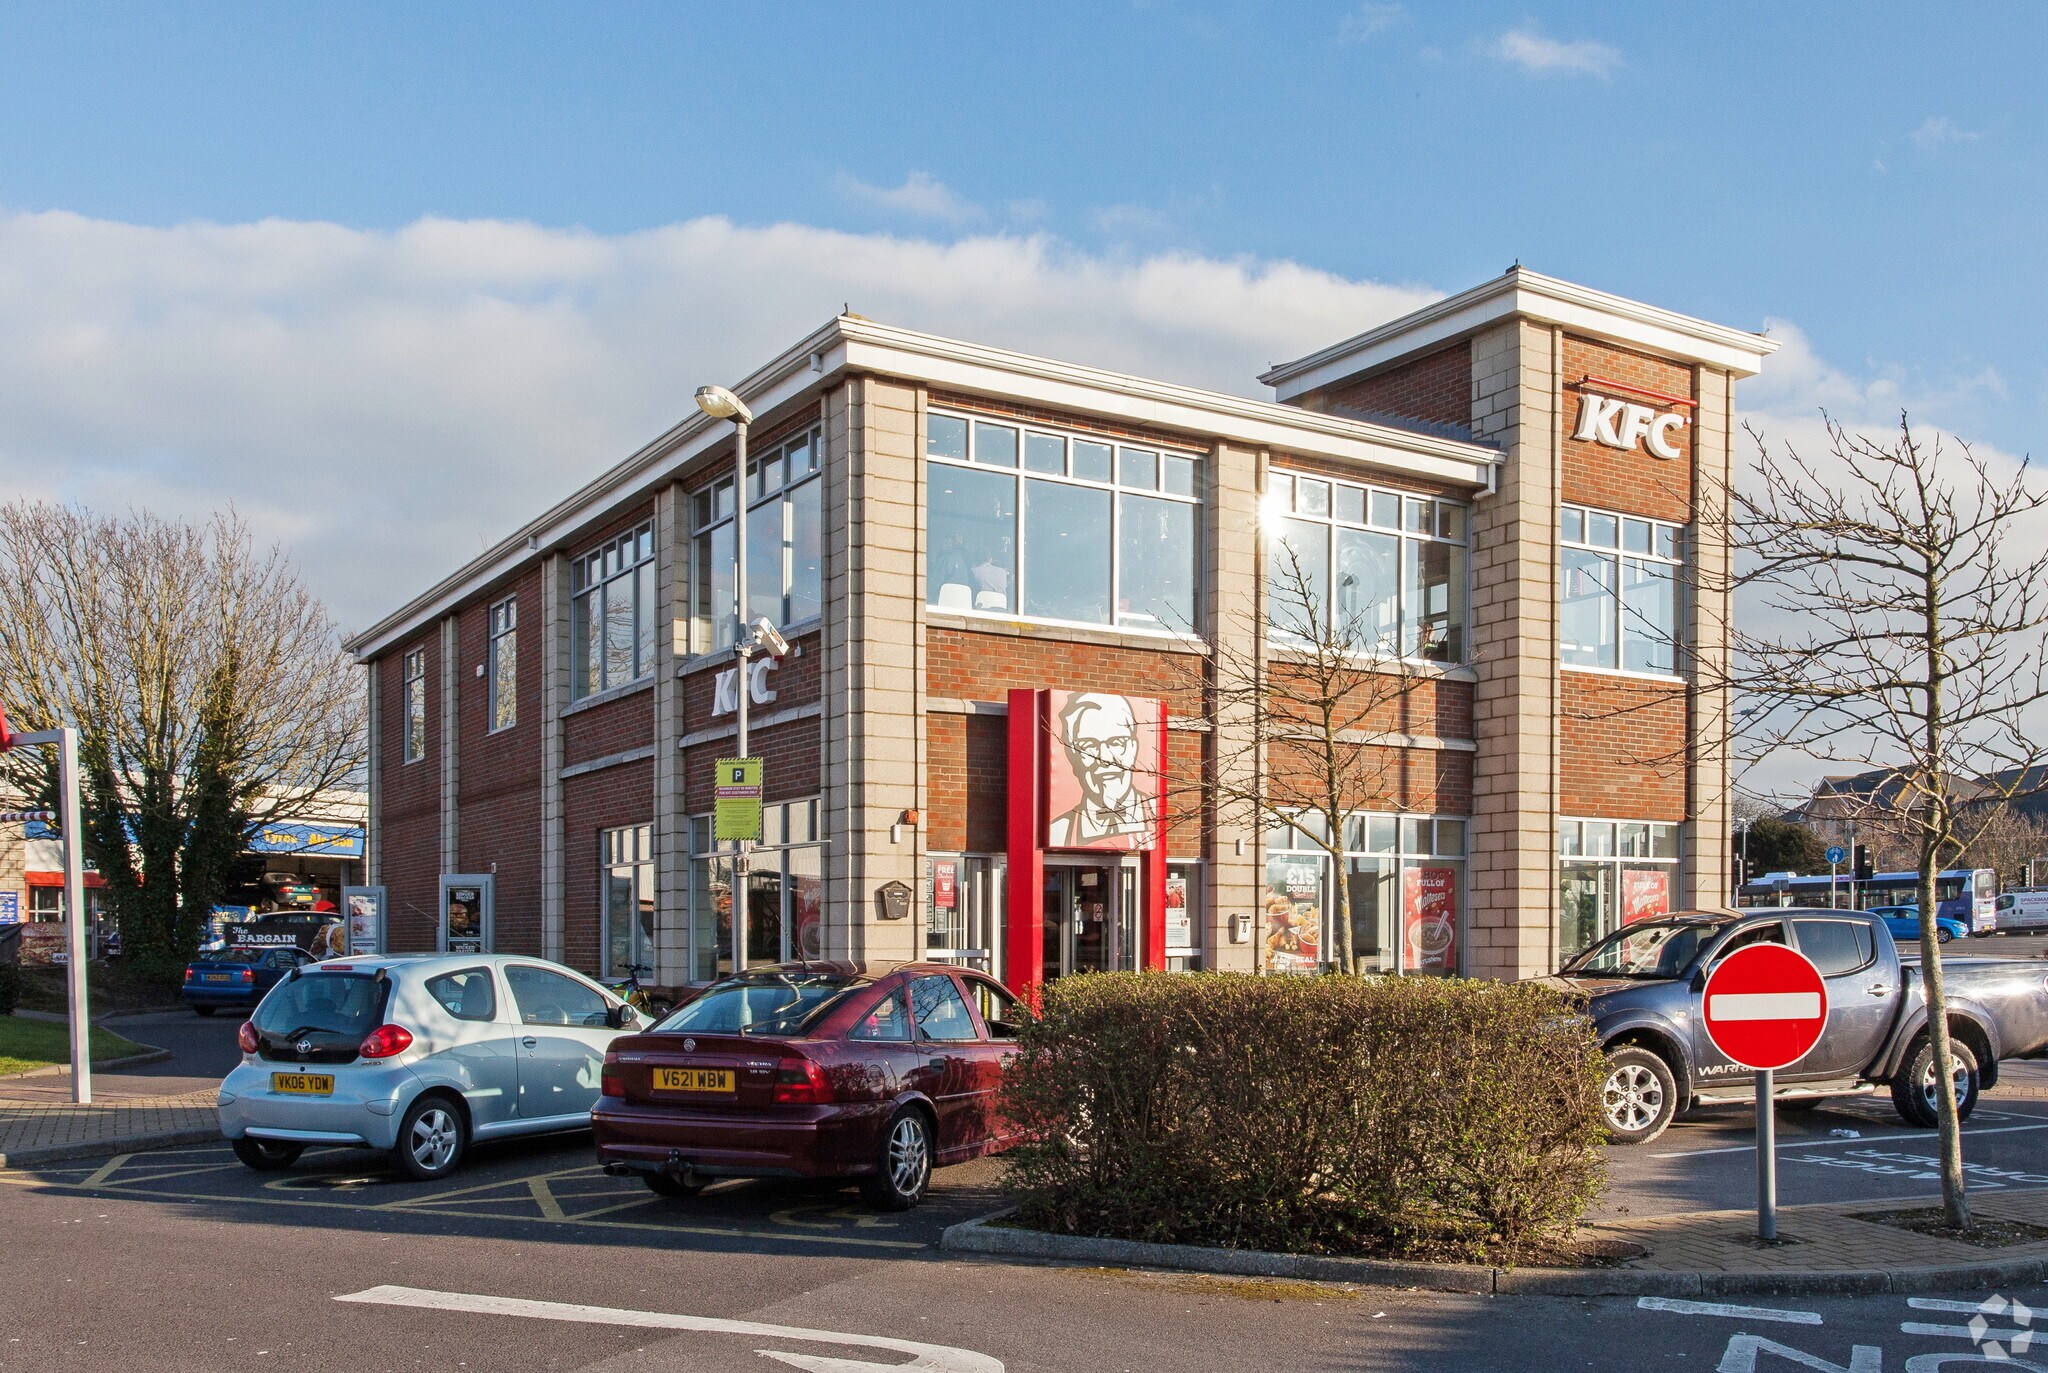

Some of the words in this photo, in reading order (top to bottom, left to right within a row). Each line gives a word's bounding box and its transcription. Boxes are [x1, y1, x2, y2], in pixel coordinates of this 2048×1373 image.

[1574, 393, 1685, 459] KFC
[735, 770, 742, 780] P
[238, 935, 296, 943] BARGAIN
[279, 1076, 305, 1089] VK06
[662, 1071, 693, 1087] V621
[698, 1072, 726, 1088] WBW
